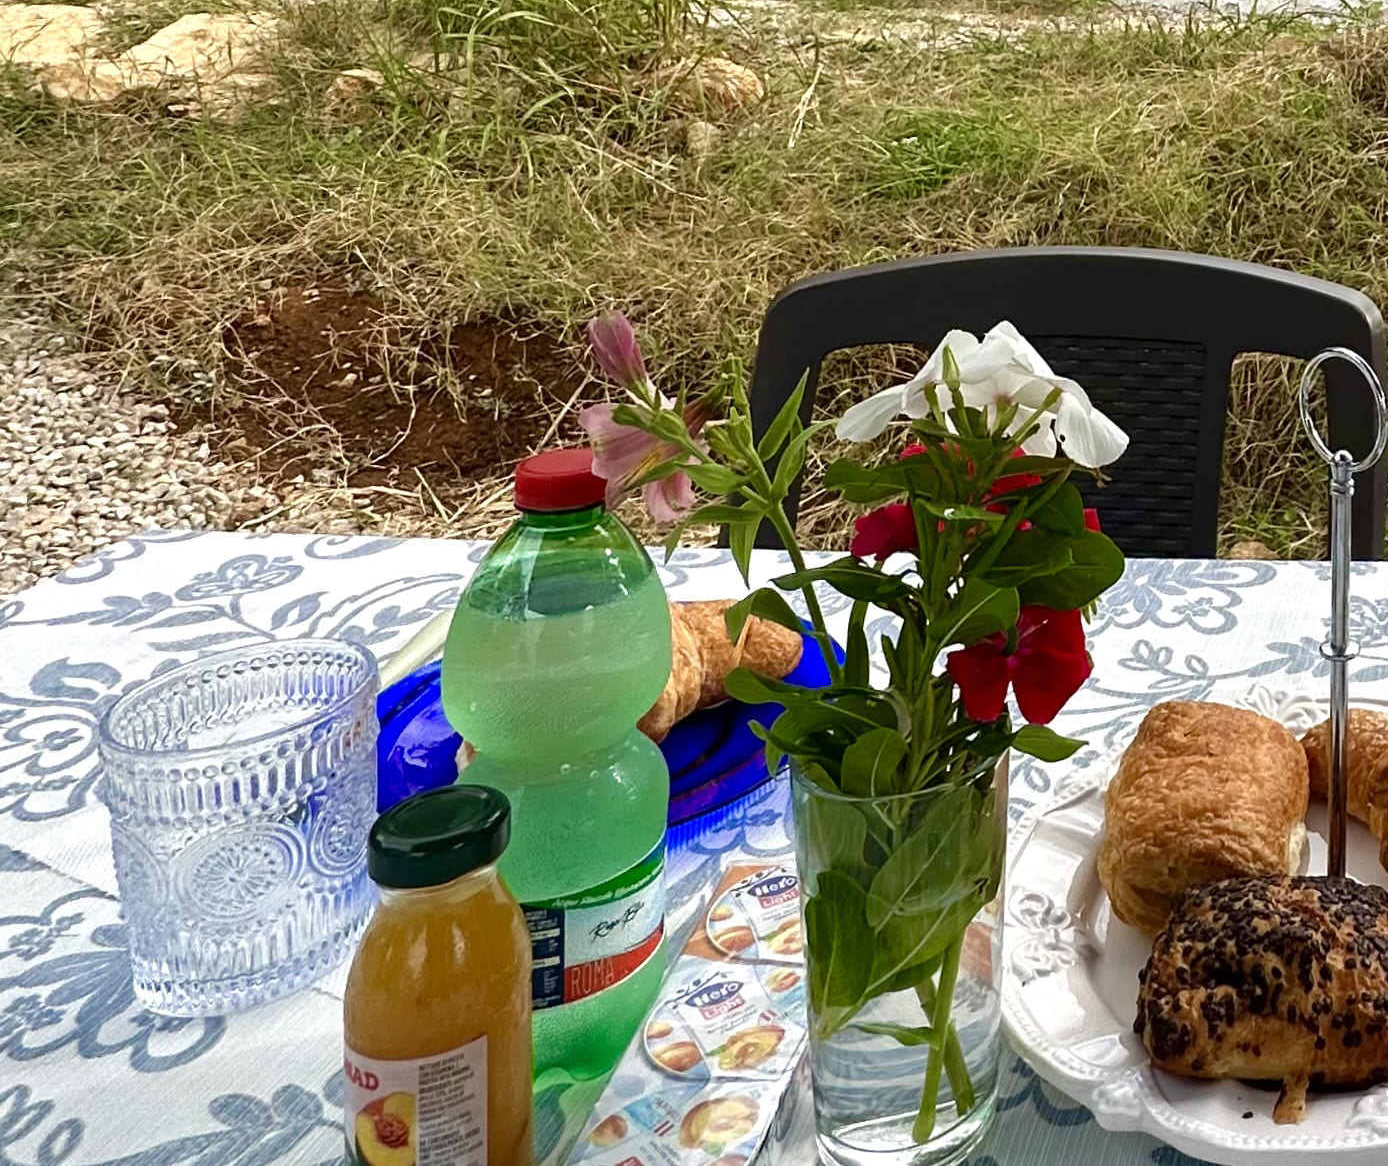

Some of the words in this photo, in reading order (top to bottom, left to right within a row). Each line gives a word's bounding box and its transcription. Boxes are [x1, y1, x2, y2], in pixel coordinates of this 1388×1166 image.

[754, 876, 797, 896] Hero
[763, 889, 799, 908] Light
[571, 957, 615, 998] ROMA
[694, 982, 739, 1005] Hero
[703, 995, 743, 1019] Light
